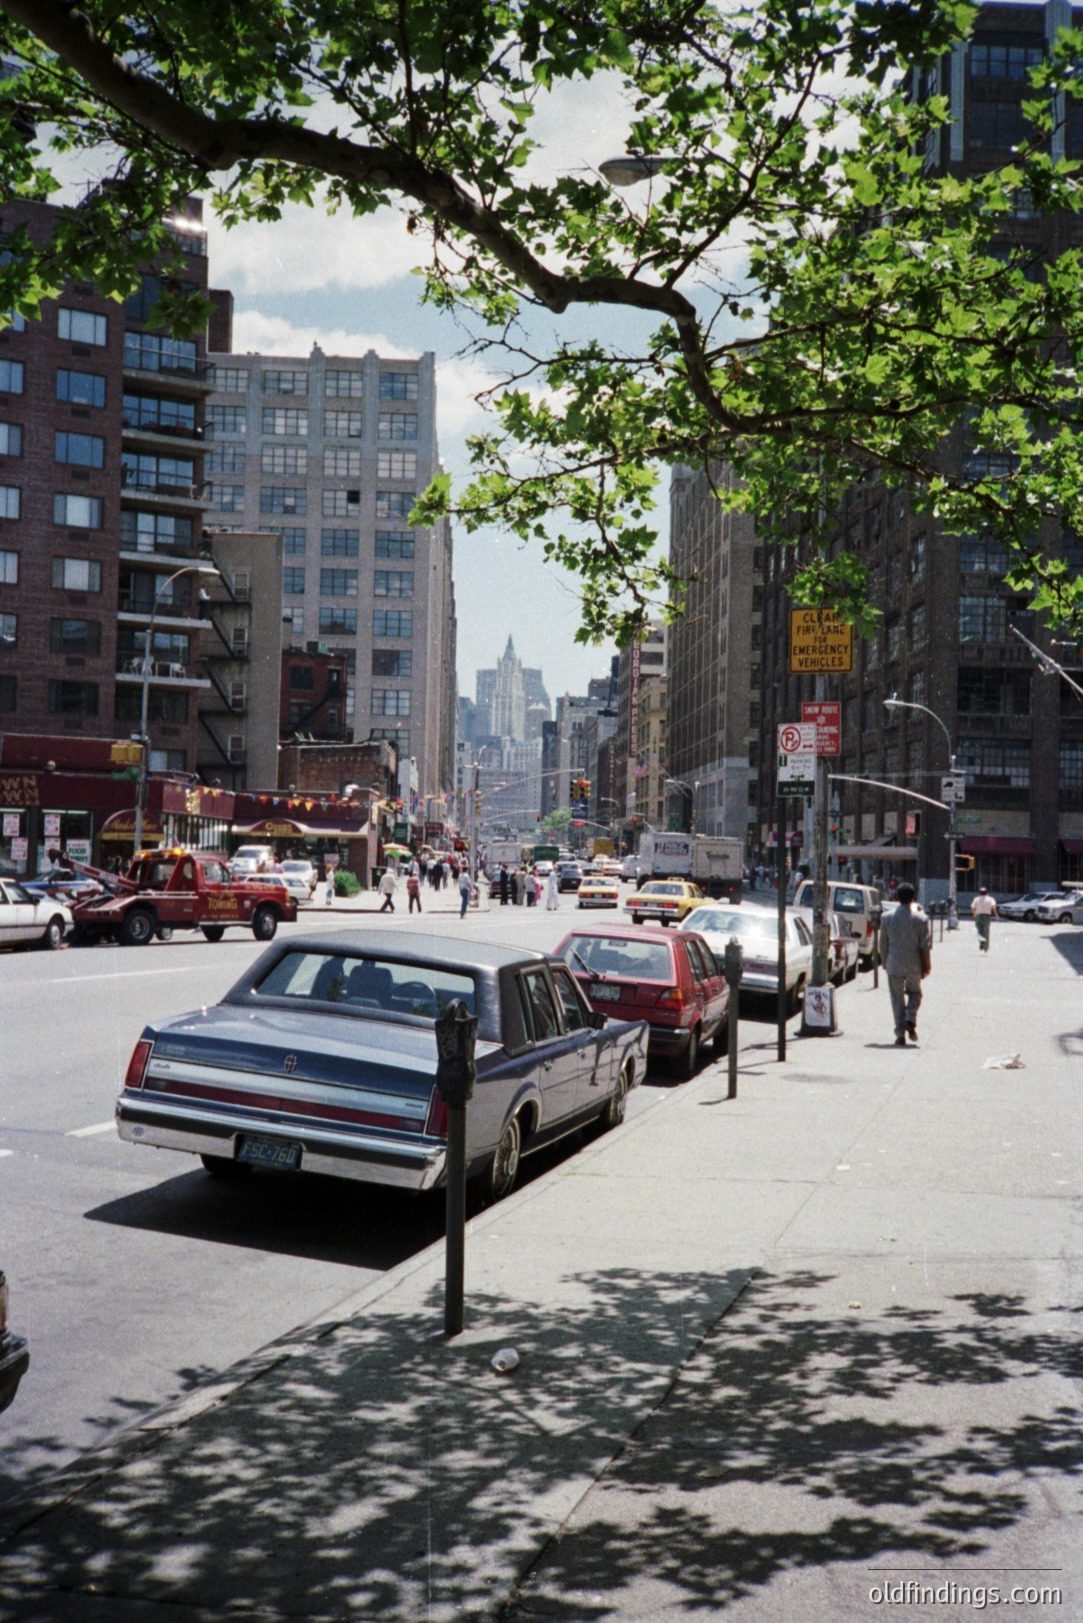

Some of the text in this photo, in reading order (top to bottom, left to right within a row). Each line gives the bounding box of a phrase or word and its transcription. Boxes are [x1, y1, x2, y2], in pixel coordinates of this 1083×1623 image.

[803, 612, 839, 623] CLAR
[796, 624, 845, 636] FIRE LANE
[813, 635, 828, 644] FOR
[792, 644, 849, 656] EMERGENCY
[798, 656, 844, 668] VEHICLES
[804, 705, 839, 714] SNOW ROUTE
[208, 896, 238, 910] TOWING
